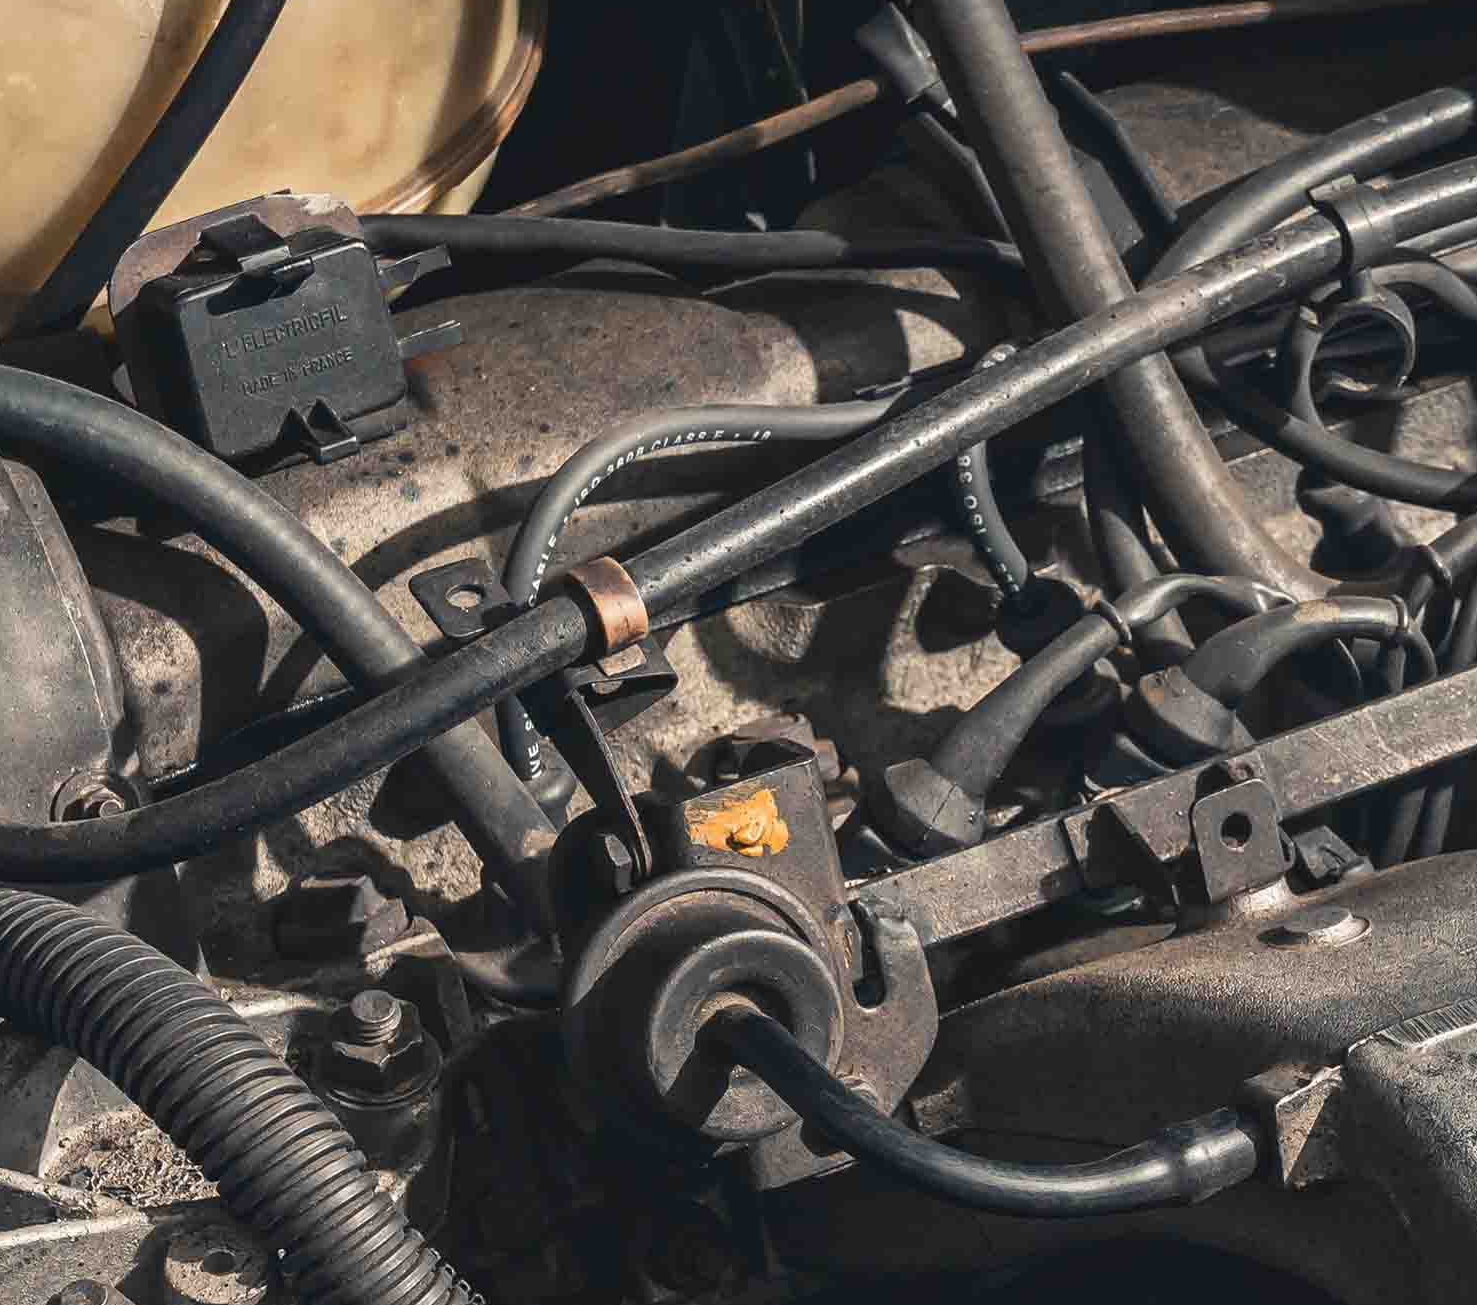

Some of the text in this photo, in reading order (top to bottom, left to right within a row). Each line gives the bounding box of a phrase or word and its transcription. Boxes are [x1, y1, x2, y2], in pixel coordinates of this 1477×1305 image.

[241, 347, 353, 396] MADE IN FRANCE
